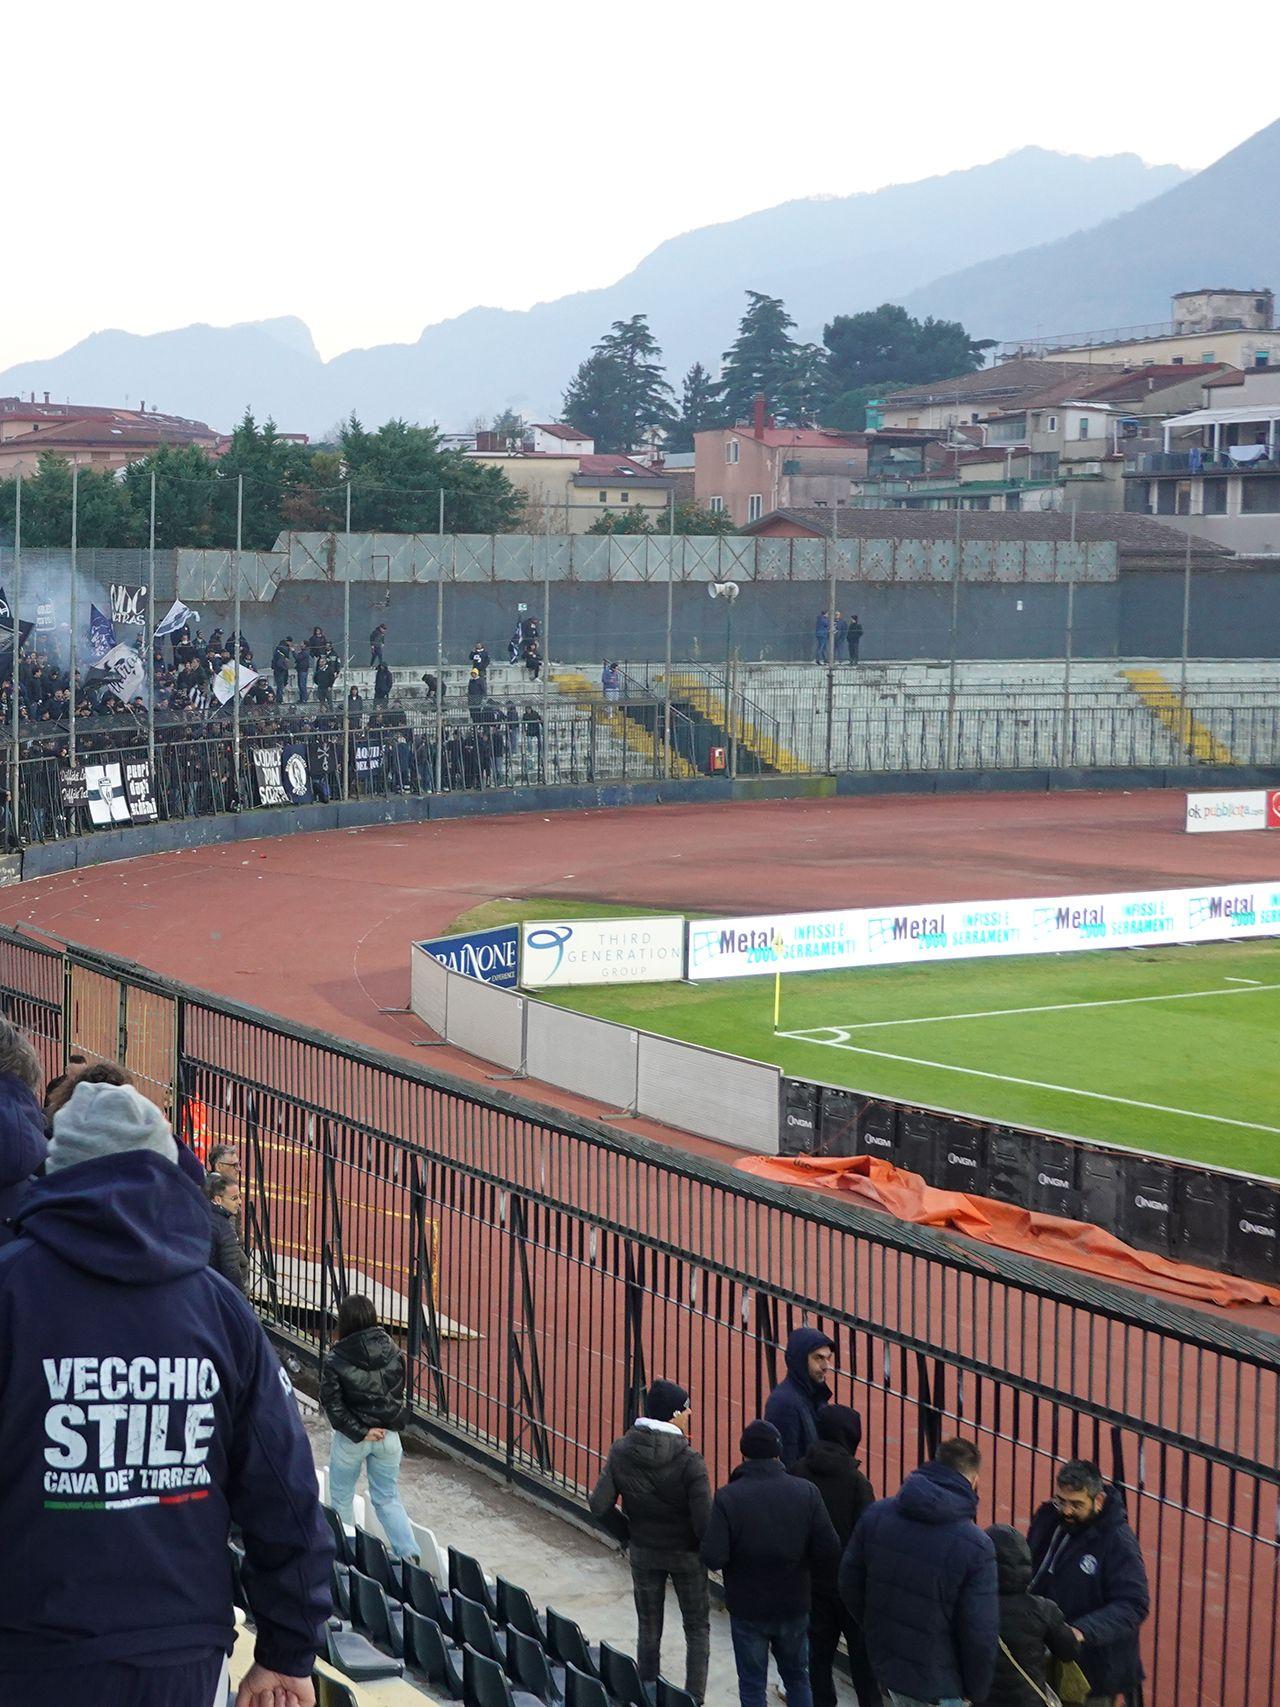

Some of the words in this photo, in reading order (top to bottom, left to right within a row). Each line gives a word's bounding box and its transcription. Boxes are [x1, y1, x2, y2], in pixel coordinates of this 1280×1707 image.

[1188, 804, 1202, 819] ok
[1056, 905, 1104, 929] Metal
[1210, 895, 1254, 919] Metal
[794, 923, 836, 938] INFISSI
[893, 915, 945, 940] Metal
[951, 928, 1020, 946] SERRAMENTI
[1111, 917, 1174, 936] SERRAMENTI
[598, 932, 652, 945] THIRD
[720, 927, 775, 953] Metal
[568, 946, 681, 963] GENERATION
[783, 939, 857, 960] SERRAMENTI
[601, 967, 648, 977] GROUP
[42, 1356, 220, 1400] VECCHIO
[43, 1402, 215, 1470] STILE
[43, 1471, 99, 1494] CAVA
